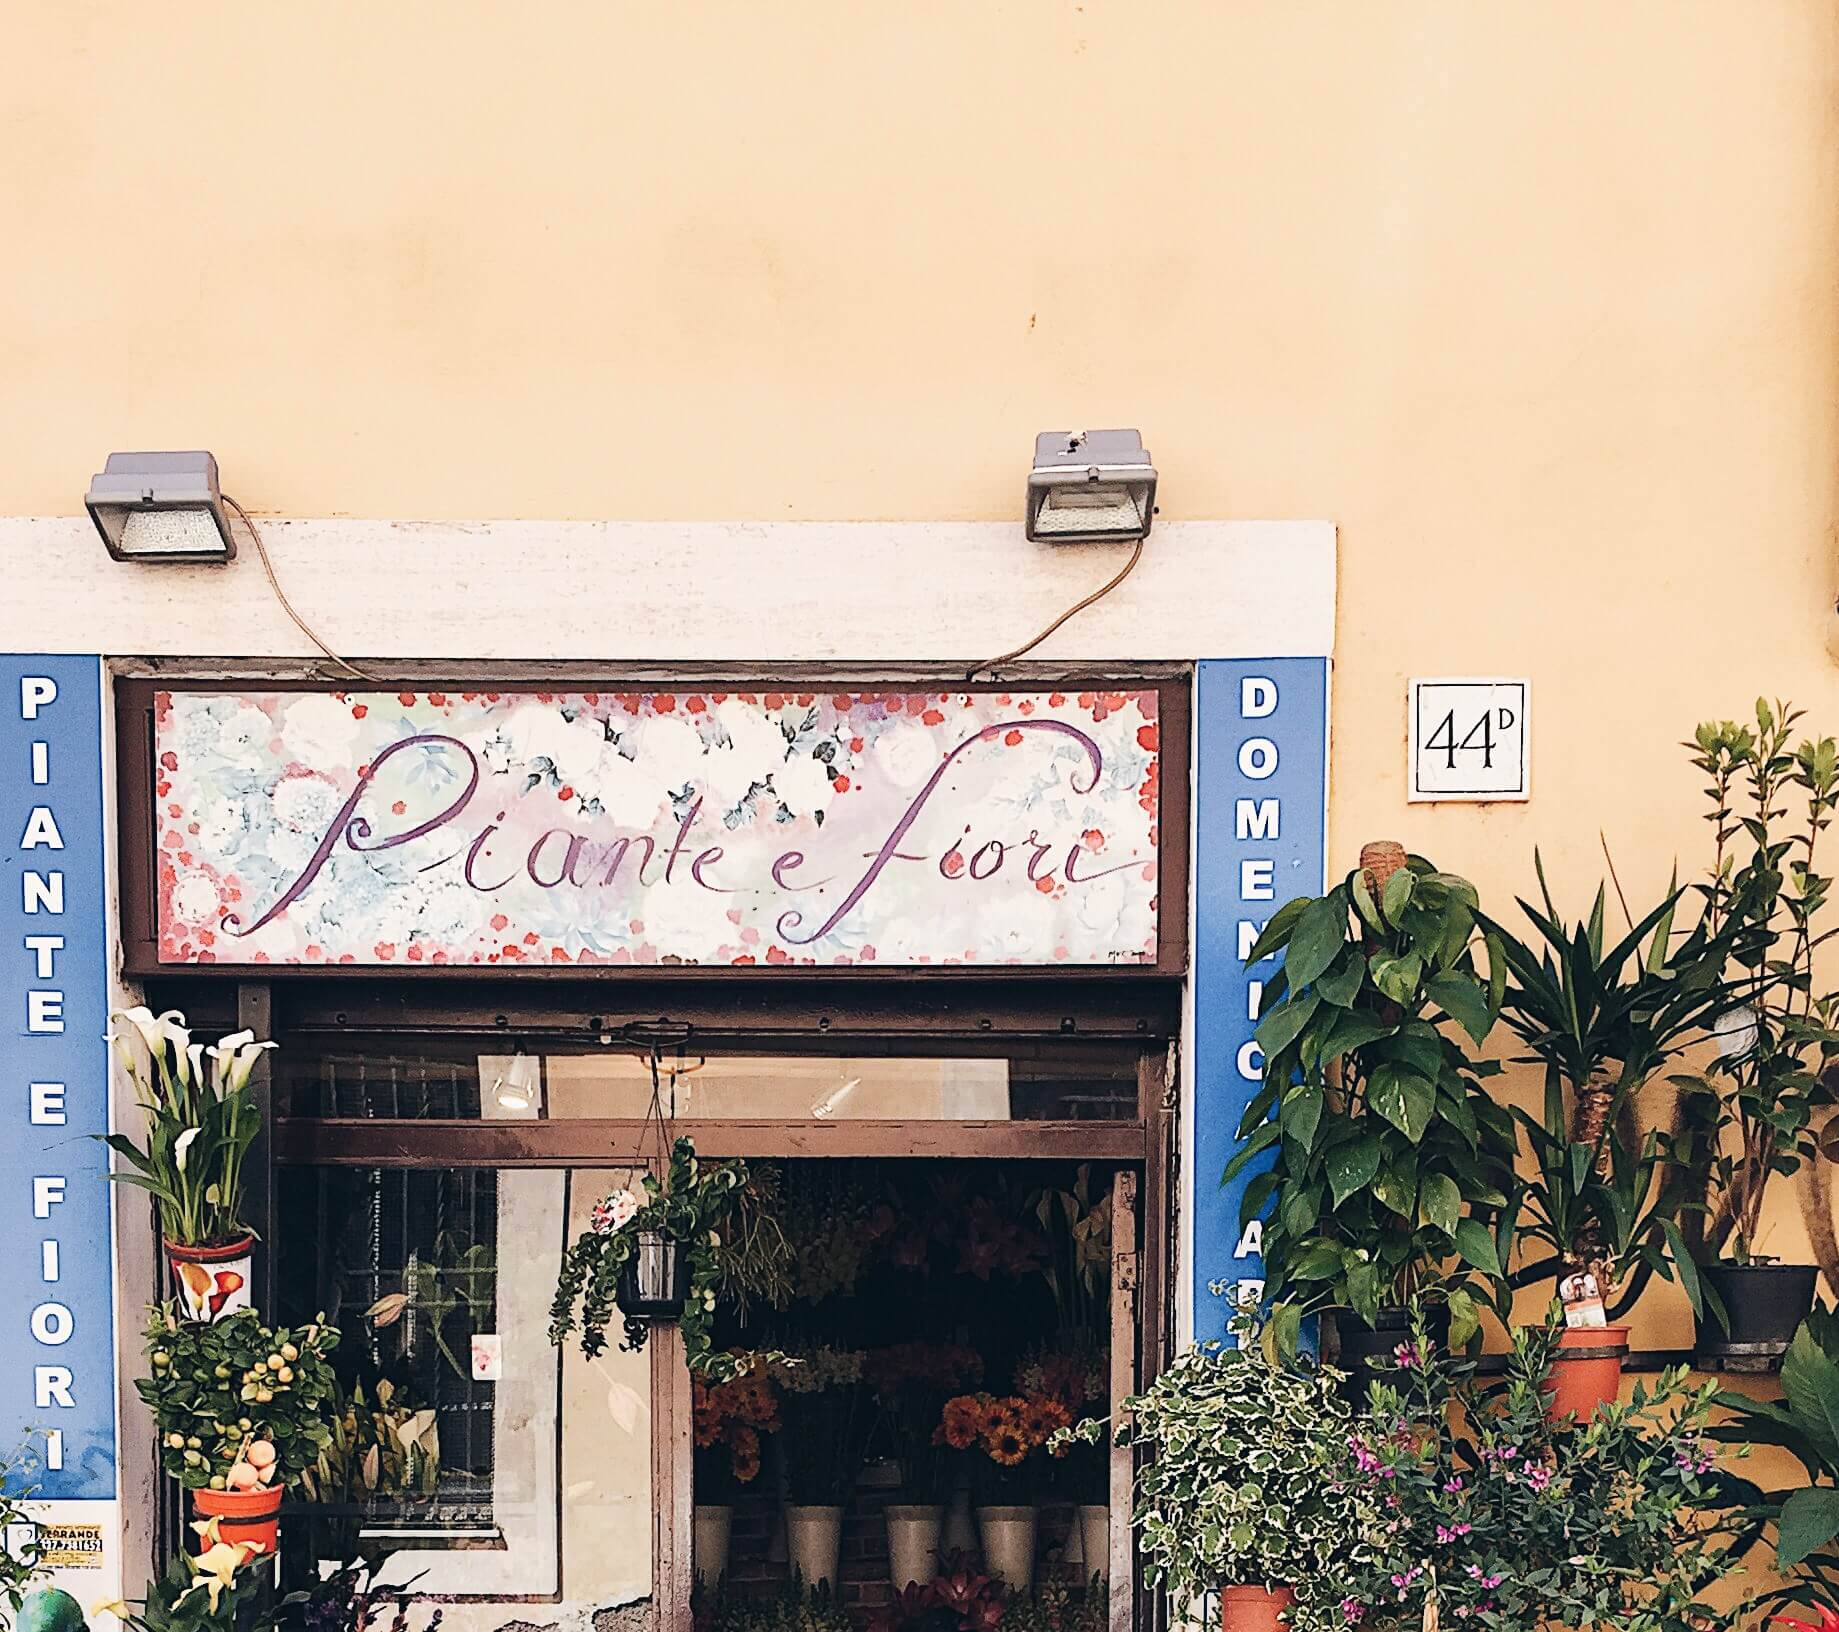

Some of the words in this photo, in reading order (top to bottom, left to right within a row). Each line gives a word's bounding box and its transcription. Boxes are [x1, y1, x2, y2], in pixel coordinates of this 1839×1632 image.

[20, 675, 65, 1033] PIANTE
[220, 735, 743, 938] Piante
[771, 850, 834, 893] e
[1234, 676, 1280, 1141] DOMENIC
[30, 1081, 66, 1125] E
[31, 1176, 75, 1470] FIORI
